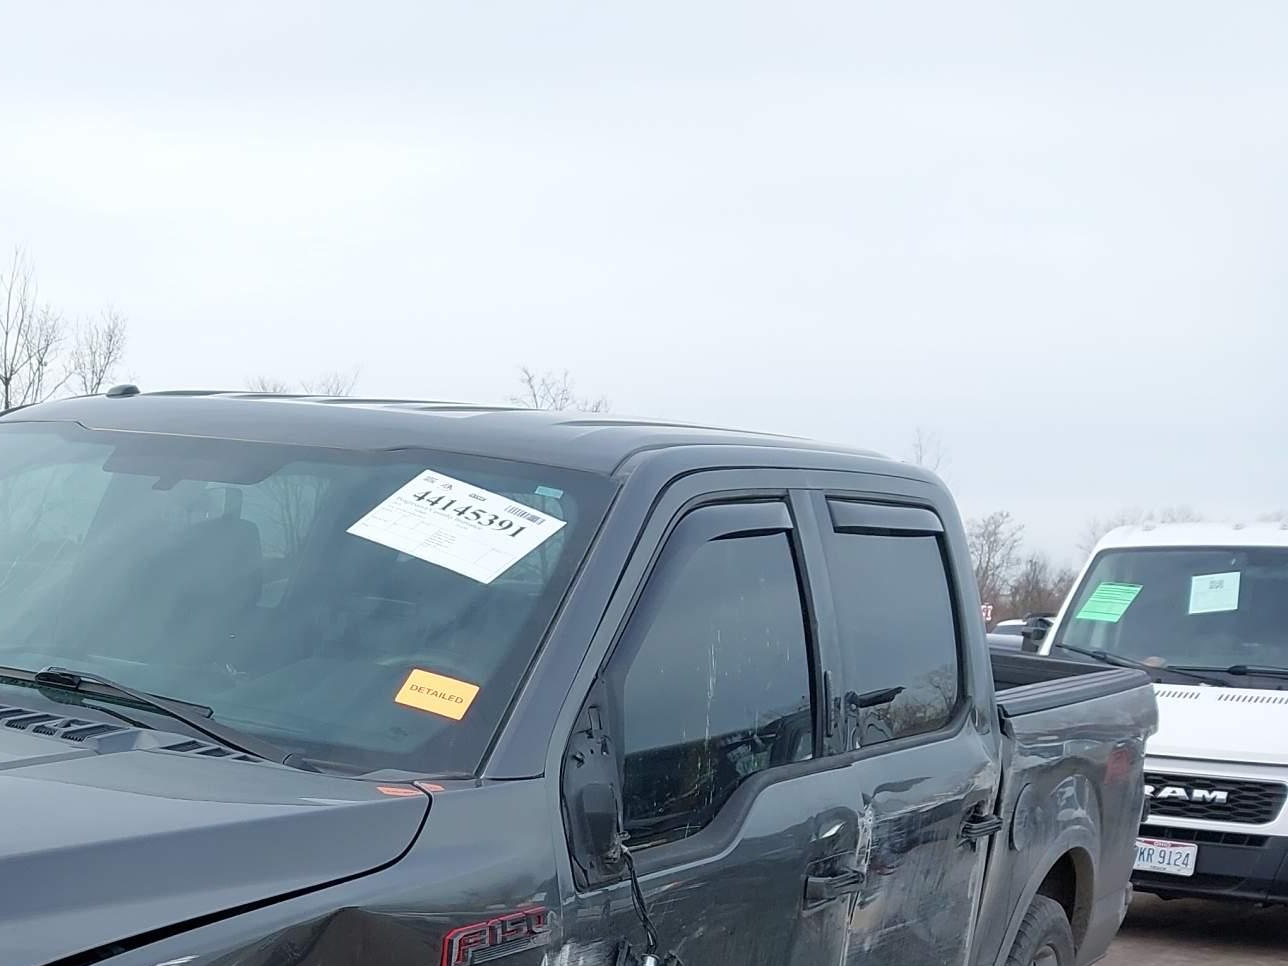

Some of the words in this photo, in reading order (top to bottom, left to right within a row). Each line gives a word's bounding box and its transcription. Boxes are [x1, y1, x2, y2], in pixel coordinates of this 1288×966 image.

[412, 490, 528, 538] 44145391
[409, 684, 464, 704] DETAILED
[1144, 784, 1229, 804] RAM
[1137, 847, 1155, 863] KR
[1158, 849, 1190, 868] 9124
